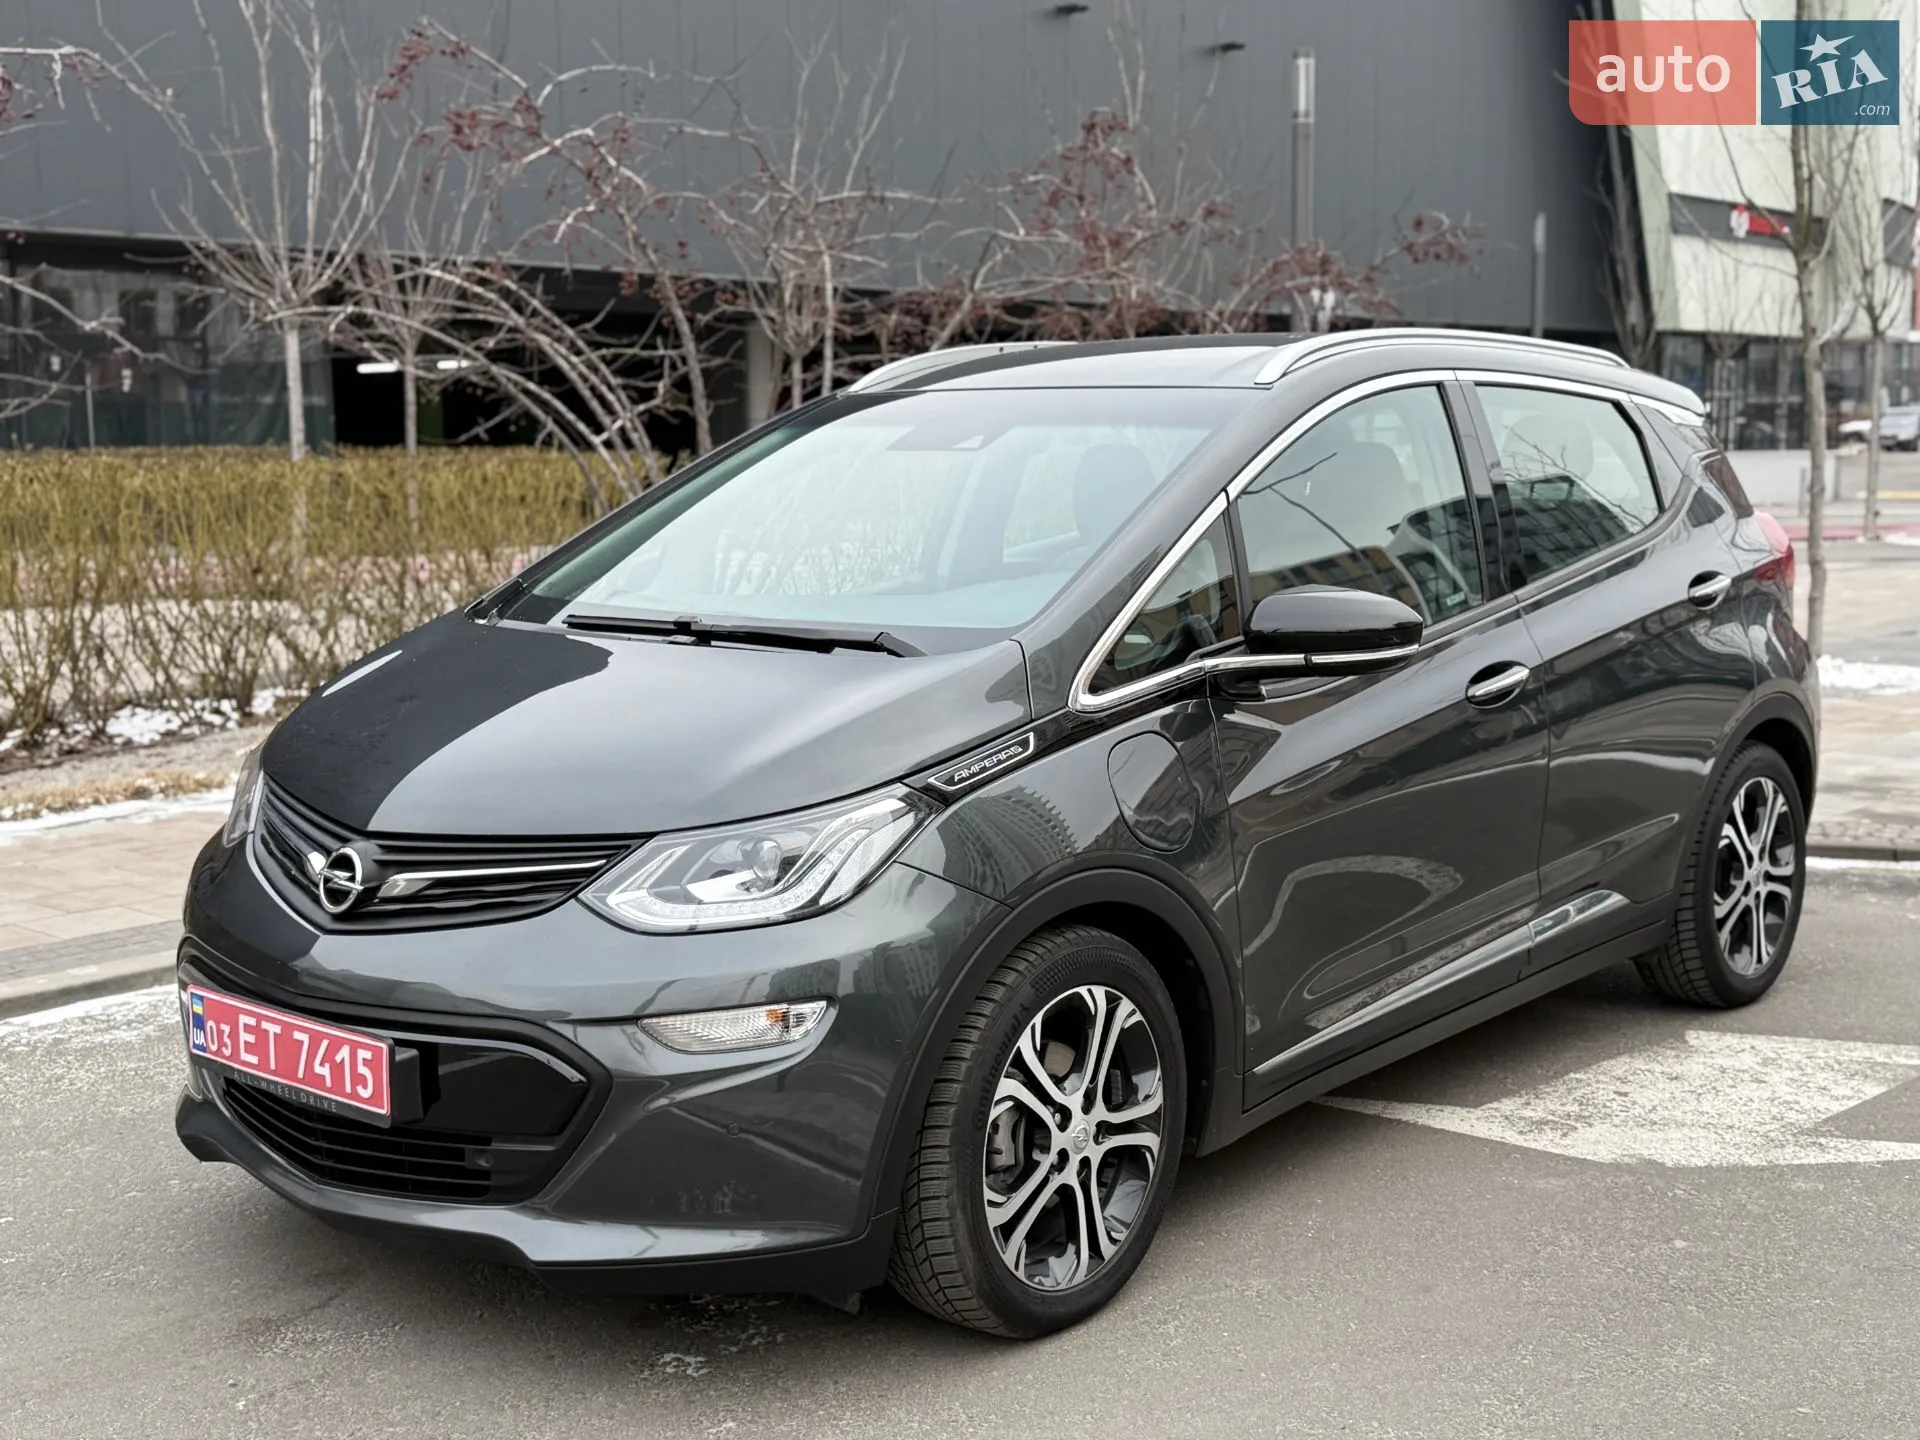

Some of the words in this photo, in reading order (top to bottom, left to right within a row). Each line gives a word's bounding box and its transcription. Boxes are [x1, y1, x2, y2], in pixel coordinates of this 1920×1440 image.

[193, 1027, 206, 1047] UA
[207, 1019, 232, 1057] 03
[238, 1013, 281, 1070] ET
[292, 1031, 374, 1099] 7415
